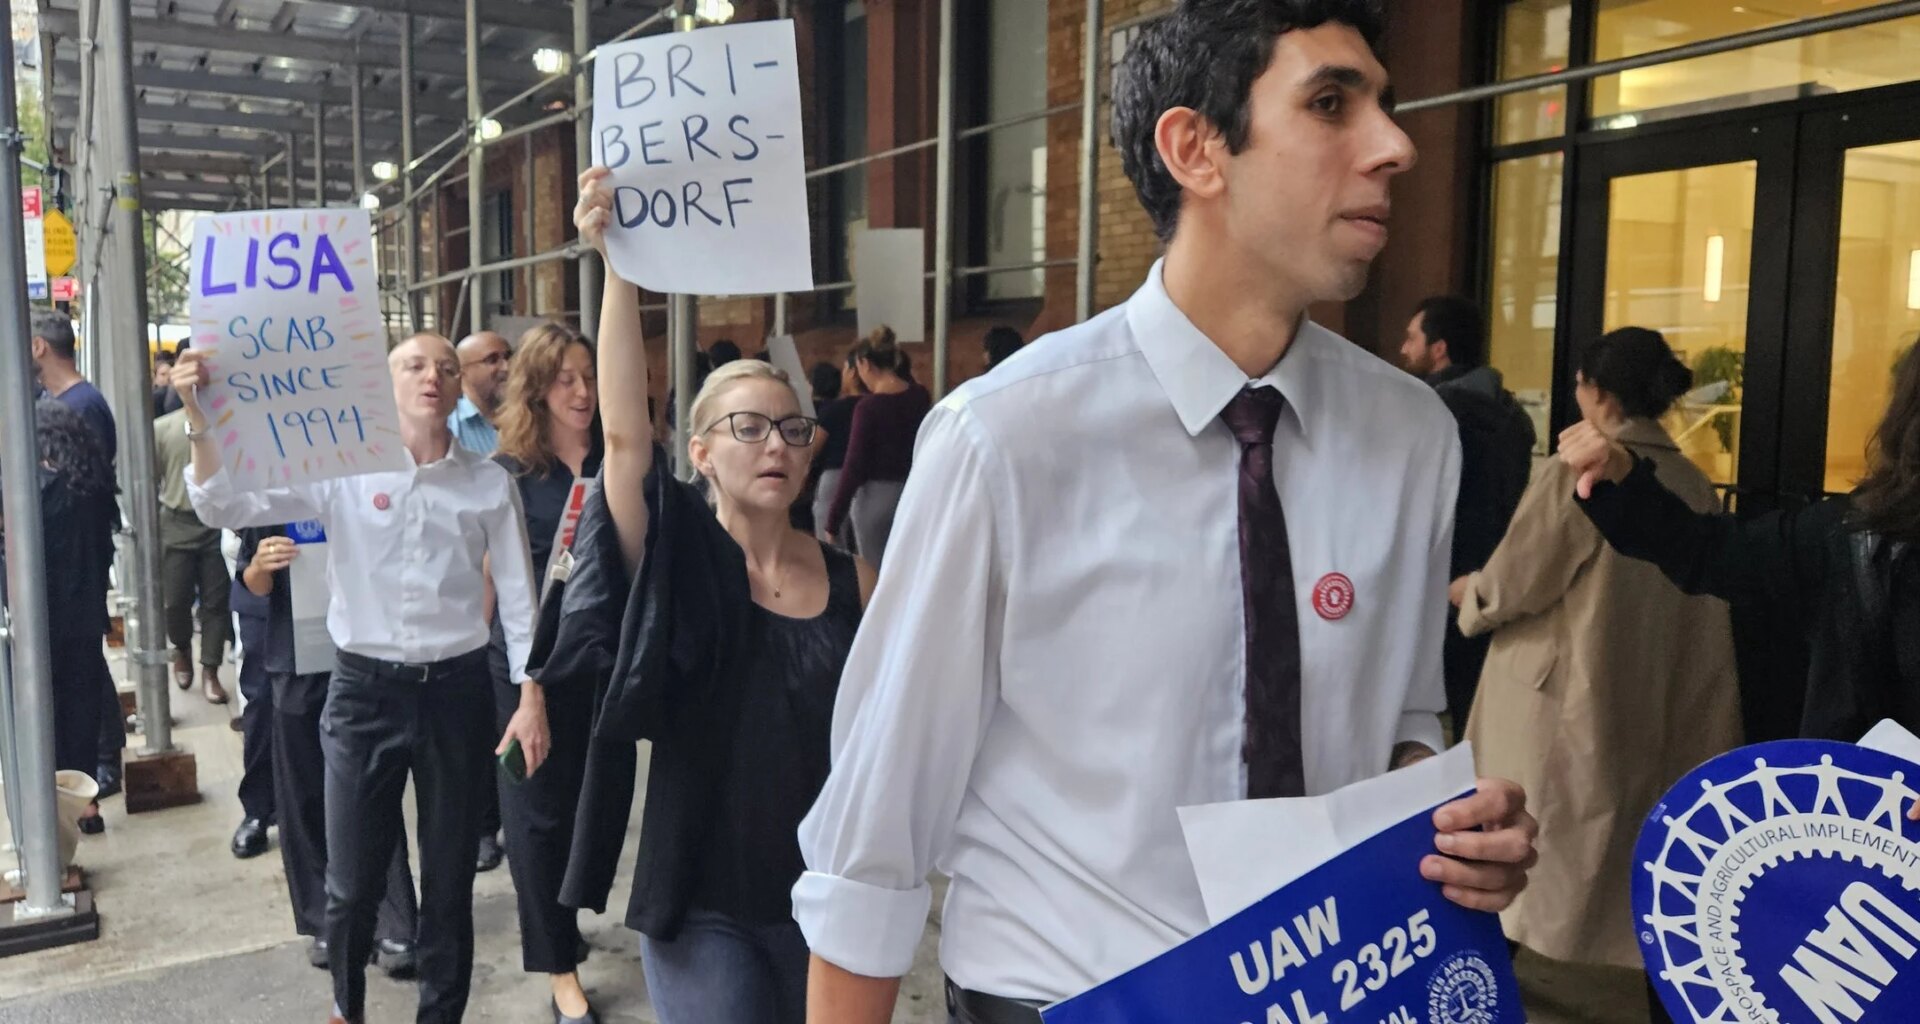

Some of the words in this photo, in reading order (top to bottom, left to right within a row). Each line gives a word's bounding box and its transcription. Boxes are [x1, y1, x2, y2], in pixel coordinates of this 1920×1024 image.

[614, 43, 779, 109] BRI-
[600, 114, 785, 170] BERS-
[613, 177, 753, 229] DORF
[202, 231, 354, 297] LISA
[228, 315, 335, 360] SCAB
[227, 364, 349, 402] SINCE
[267, 405, 374, 459] 1994
[1710, 823, 1801, 905] AGRICULTURAL
[1229, 896, 1342, 995] UAW
[1707, 906, 1724, 942] AND
[1779, 881, 1920, 1024] UAW
[1239, 989, 1329, 1024] AL
[1332, 907, 1438, 1012] 2325
